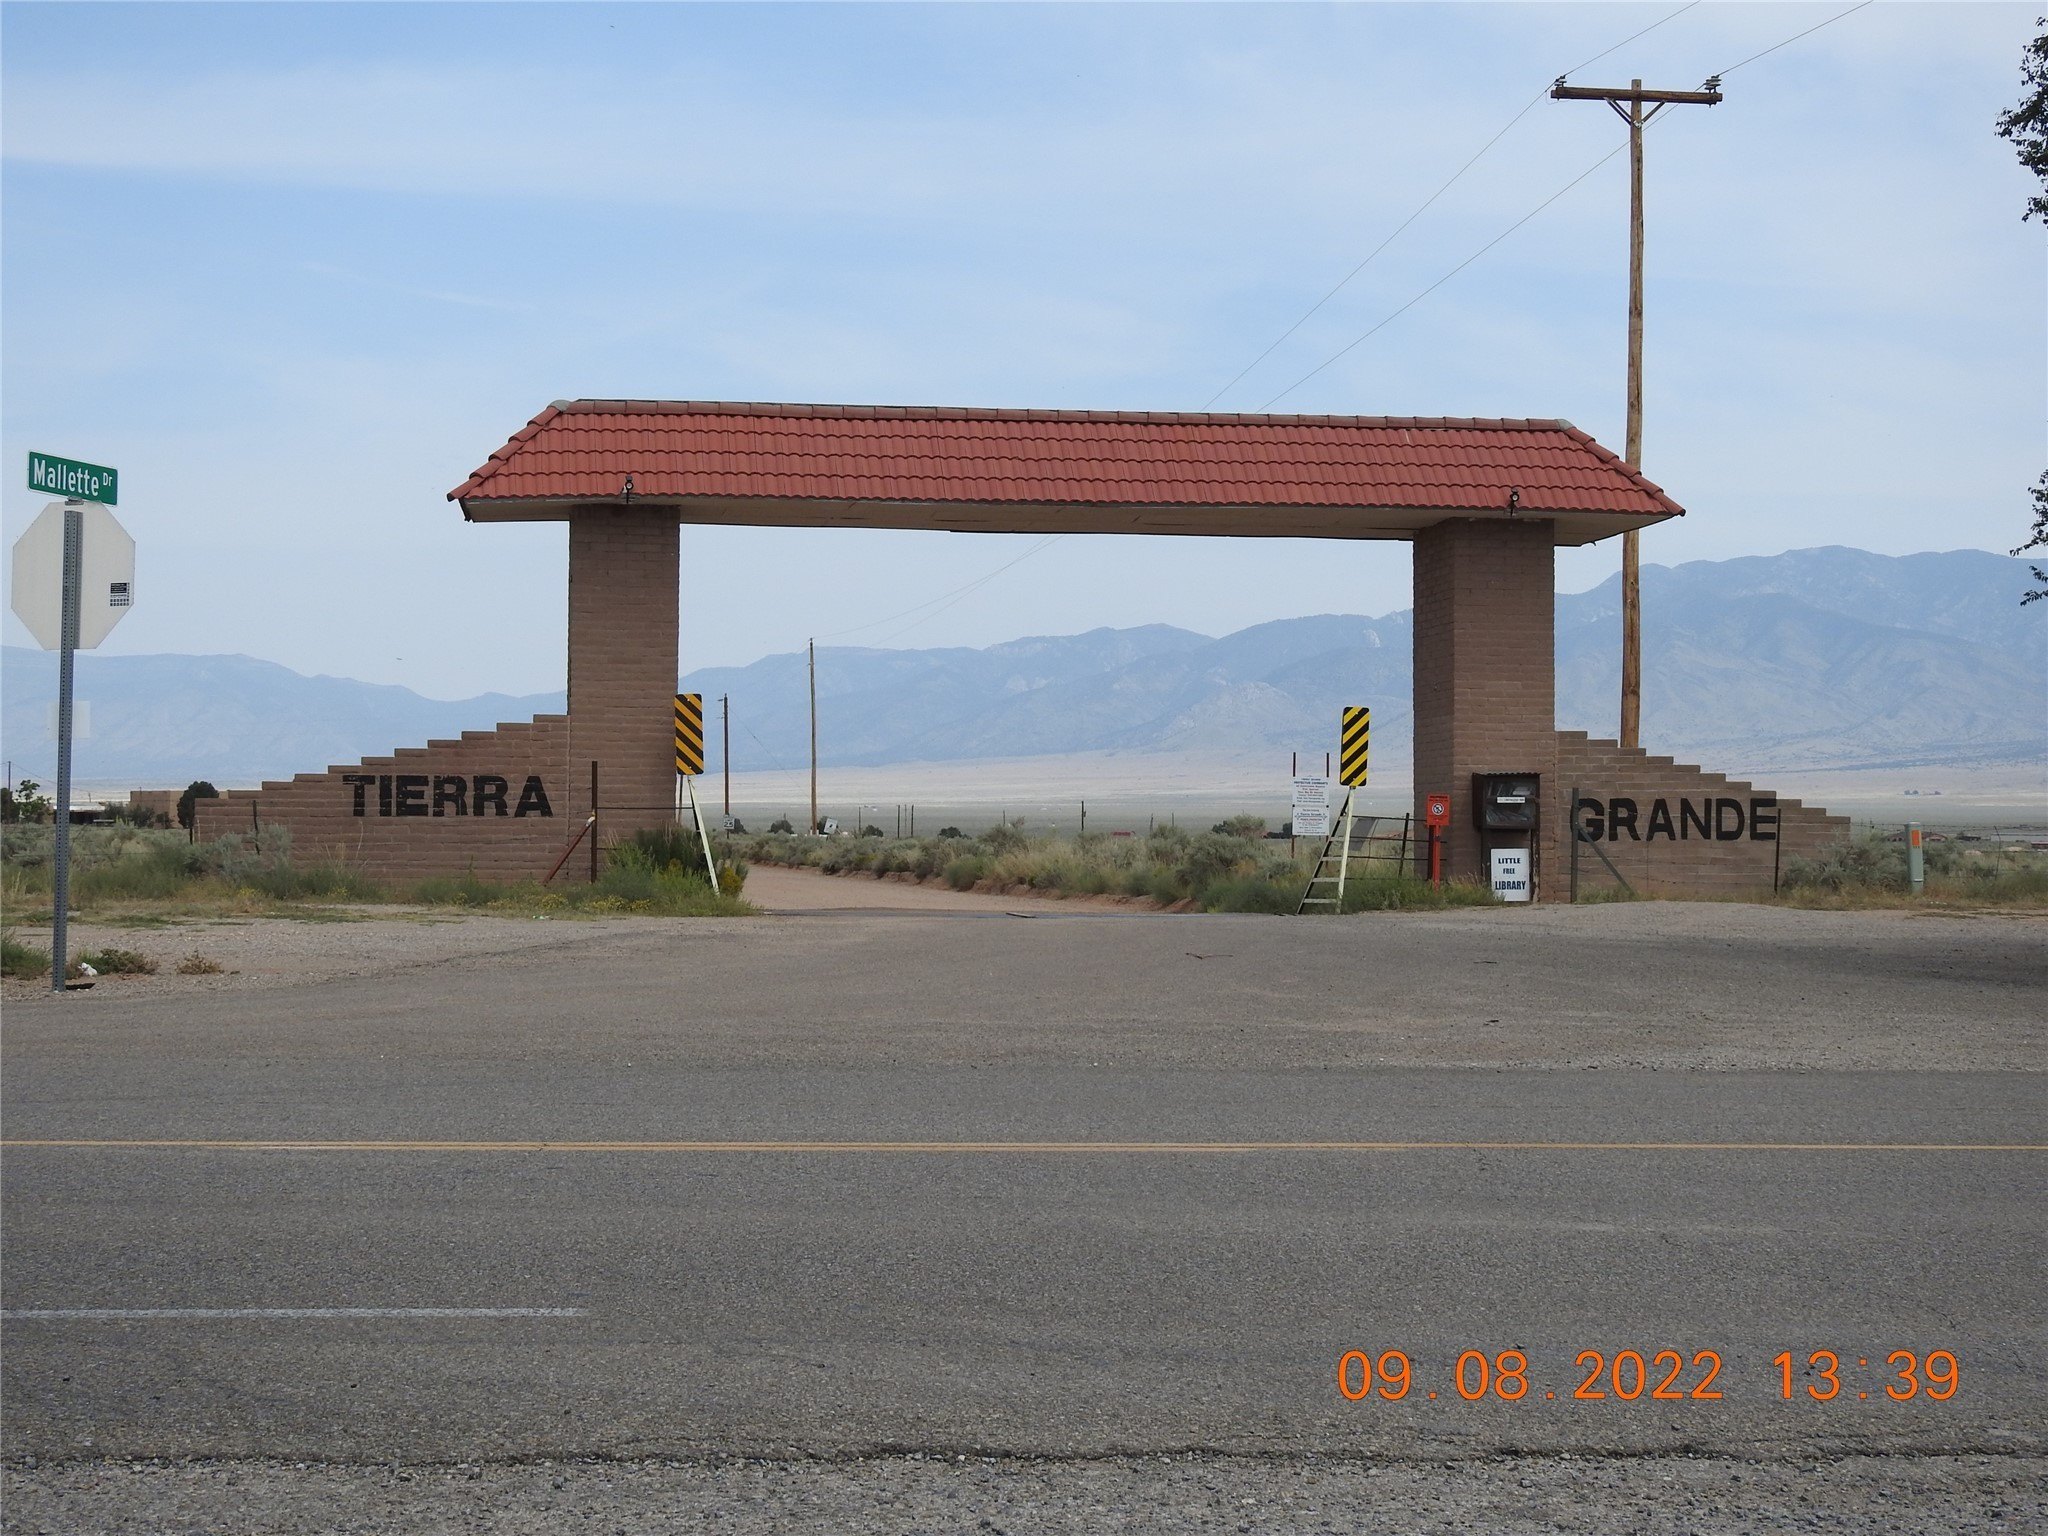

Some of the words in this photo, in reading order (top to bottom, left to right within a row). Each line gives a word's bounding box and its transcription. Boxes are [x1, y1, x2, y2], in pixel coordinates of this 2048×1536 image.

[33, 458, 99, 496] Mallette
[102, 472, 113, 487] Dr
[342, 774, 553, 817] TIERRA
[1570, 797, 1777, 842] GRANDE
[1495, 880, 1526, 890] LIBRARY
[1502, 867, 1515, 875] FREE
